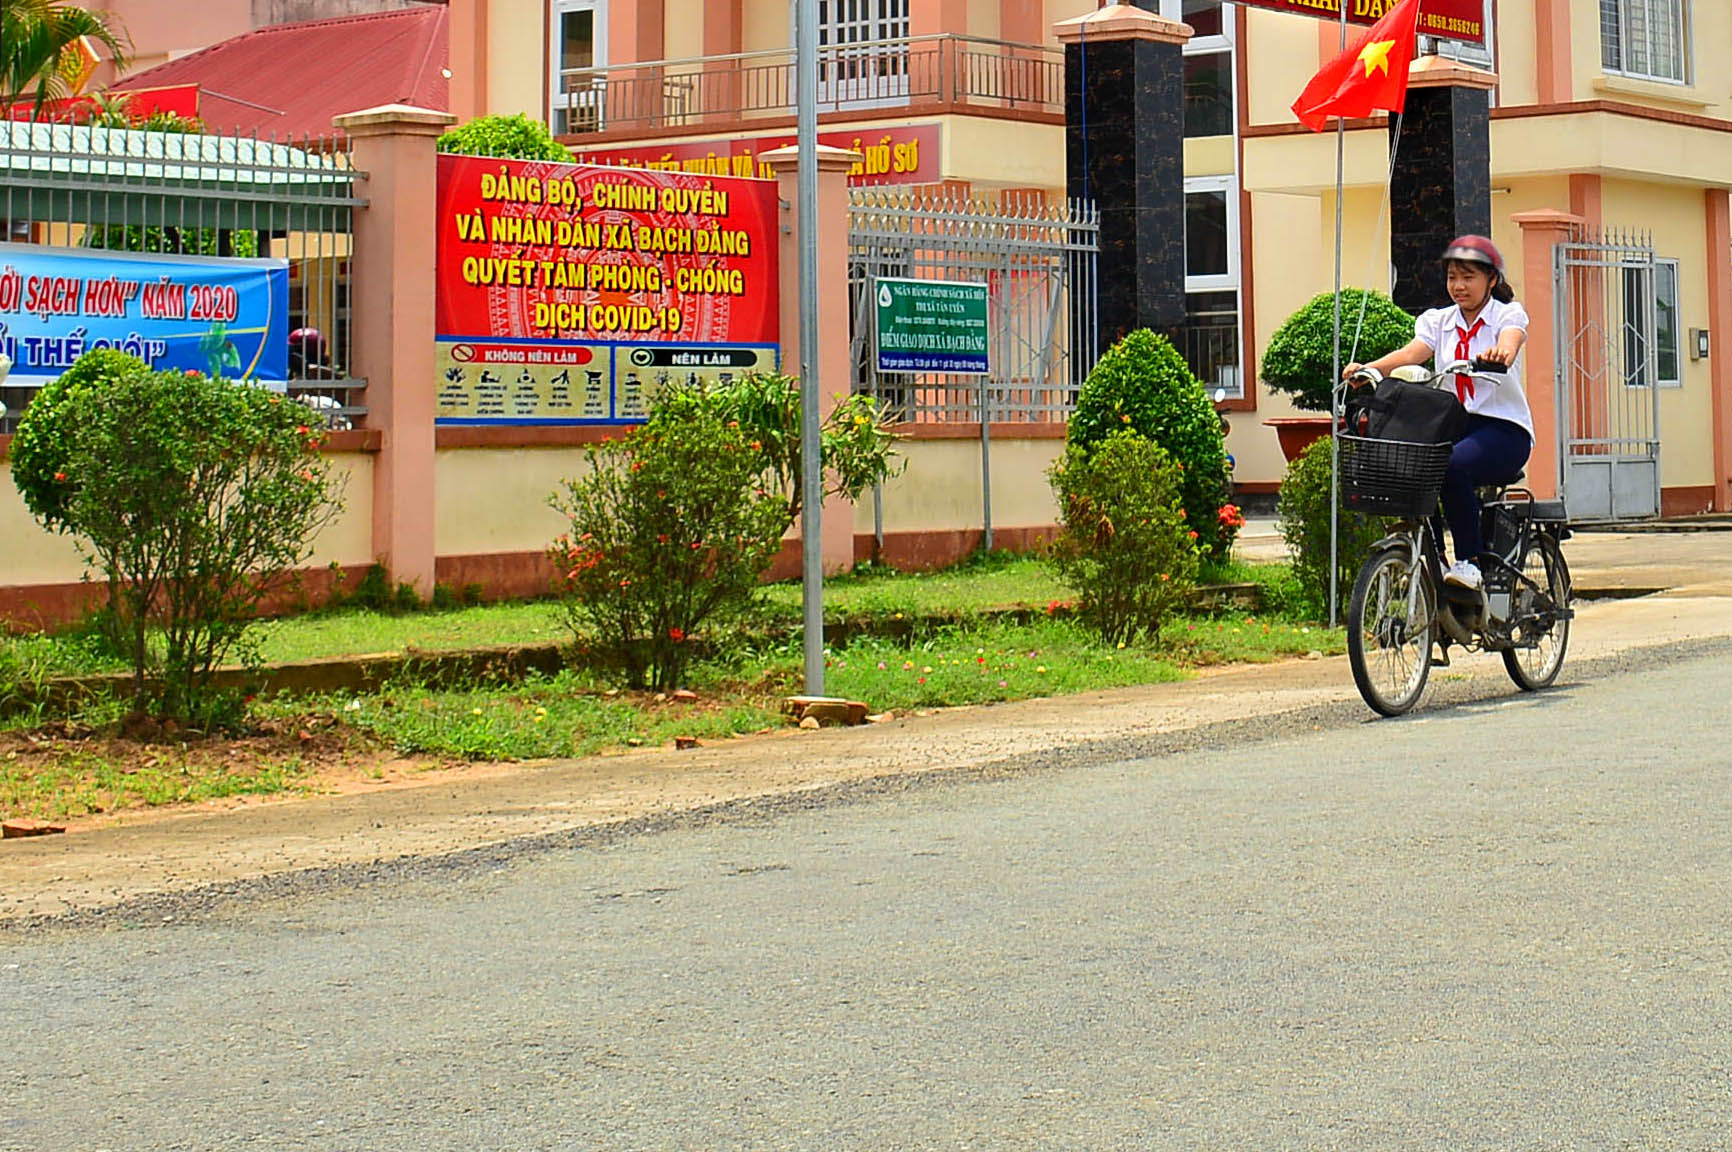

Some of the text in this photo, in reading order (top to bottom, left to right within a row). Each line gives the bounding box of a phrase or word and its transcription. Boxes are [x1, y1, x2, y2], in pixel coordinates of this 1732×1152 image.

[866, 135, 891, 174] HỒ
[894, 138, 919, 173] SƠ
[481, 165, 728, 216] ĐẢNG BỘ, CHÍNH QUYỀN
[456, 208, 750, 259] VÀ NHÂN DÂN XÃ BẠCH ĐẰNG
[462, 250, 535, 286] QUYẾT
[542, 258, 585, 288] TÂM
[591, 261, 660, 292] PHÒNG
[677, 262, 743, 294] CHỐNG
[25, 275, 80, 321] SẠCH
[142, 276, 185, 319] NĂM
[190, 284, 237, 321] 2020
[536, 303, 681, 338] DỊCH COVID-19
[24, 325, 86, 366] THẾ
[485, 349, 577, 363] KHÔNG NÊN LÀM
[672, 352, 731, 365] NÊN LÀM
[900, 333, 918, 348] GIAO
[918, 333, 935, 351] DỊCH
[935, 331, 946, 349] XÃ
[947, 334, 965, 352] BẠCH
